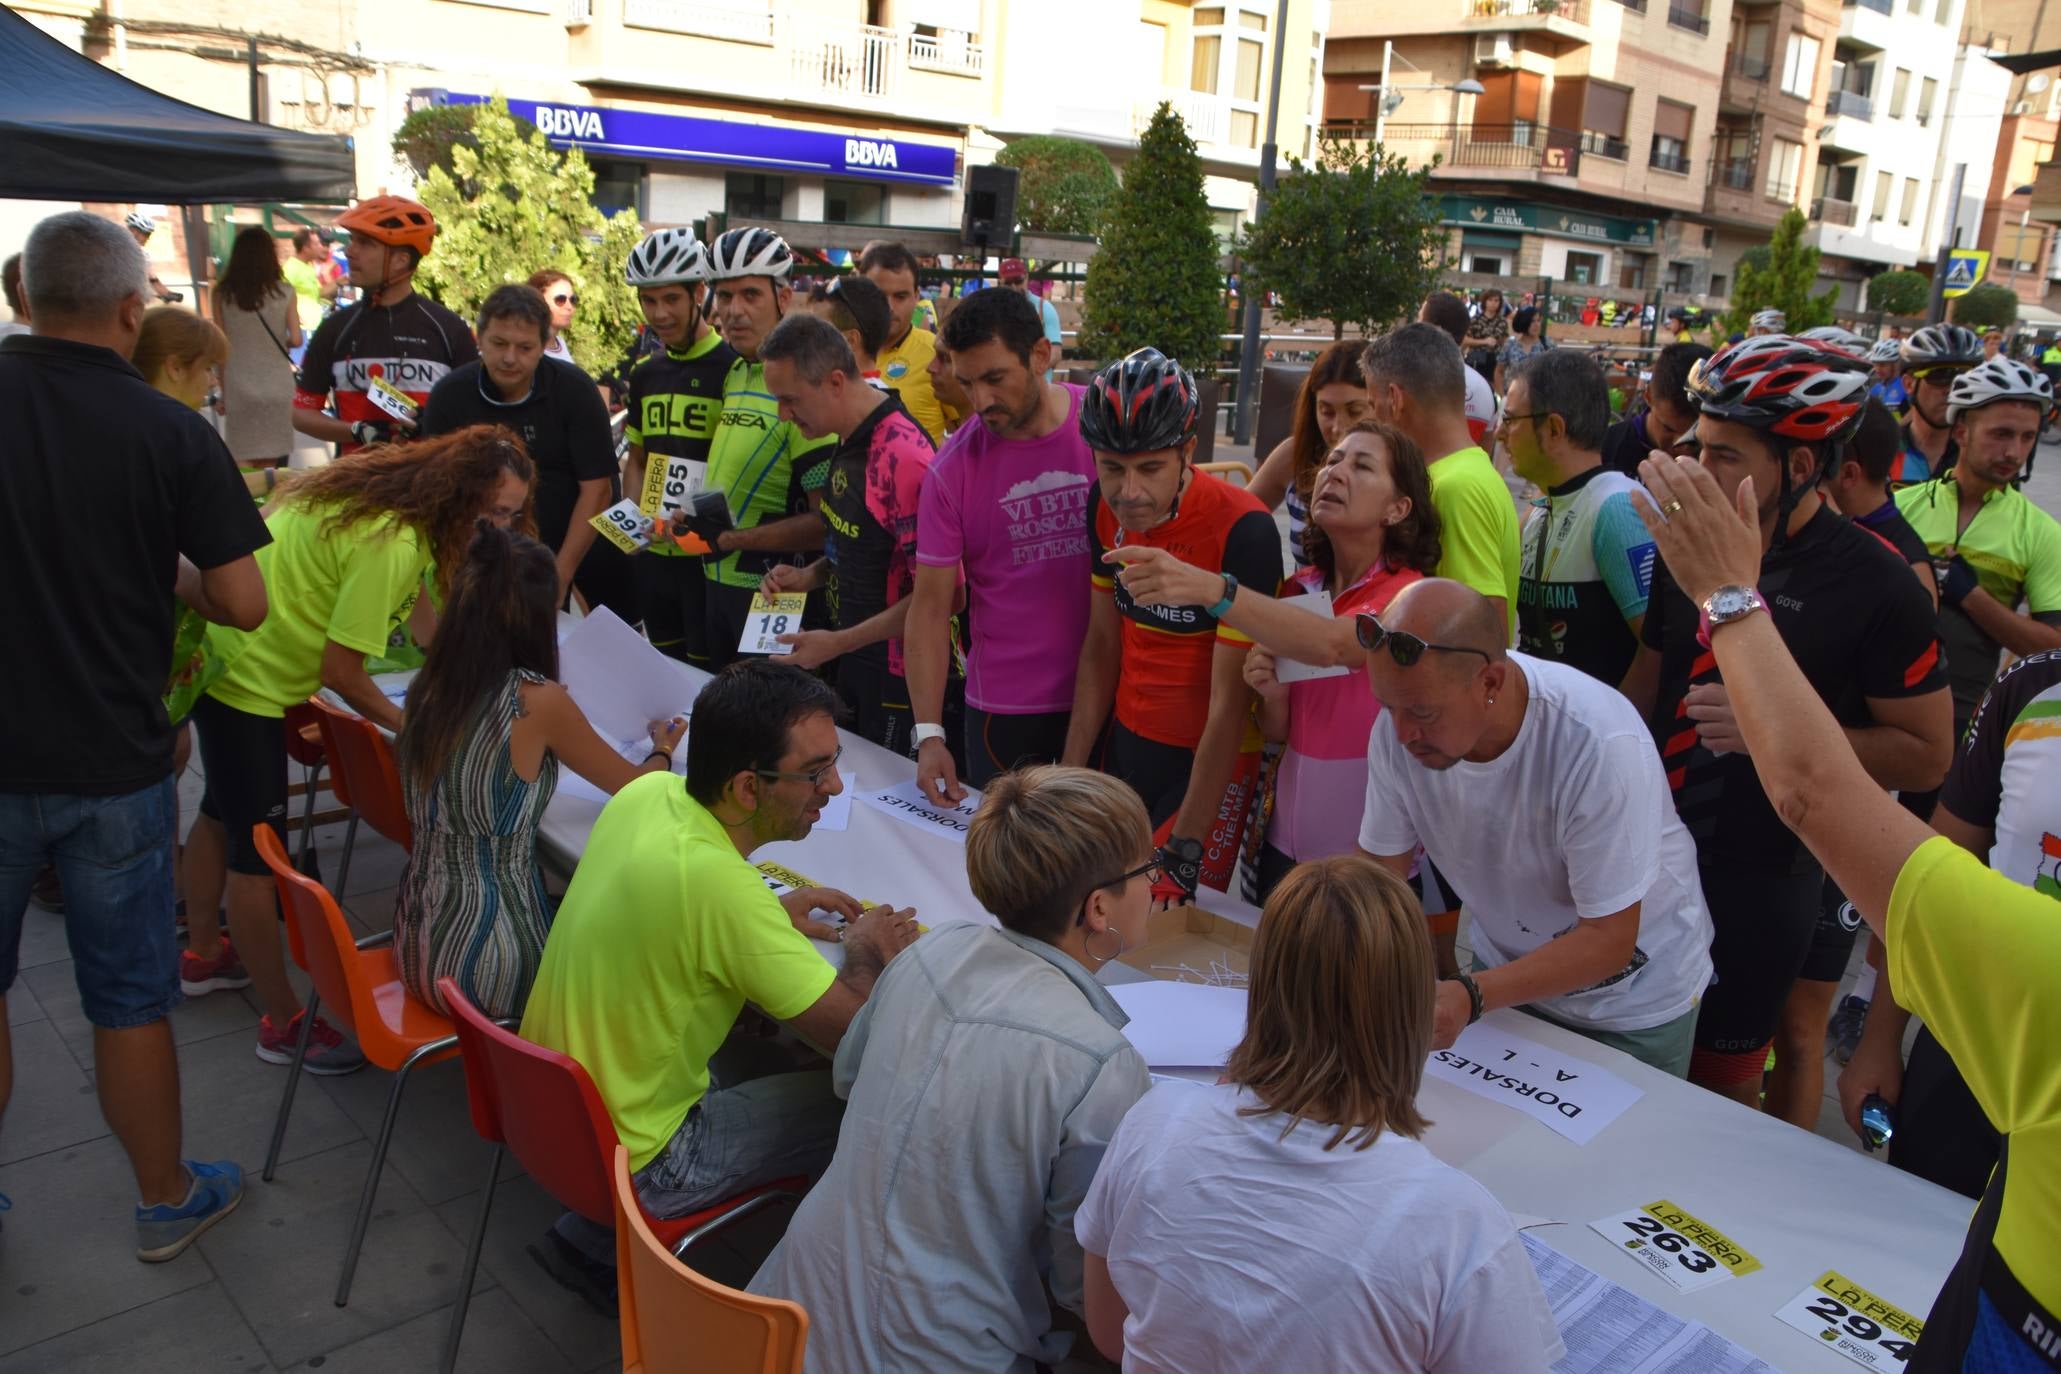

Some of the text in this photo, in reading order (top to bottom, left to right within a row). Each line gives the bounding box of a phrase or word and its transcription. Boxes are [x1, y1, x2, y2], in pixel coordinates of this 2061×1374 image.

[536, 106, 605, 139] BBVA
[845, 139, 898, 168] BBVA
[720, 413, 767, 430] RBEA
[650, 458, 666, 493] PERA
[663, 464, 689, 512] 165
[1001, 487, 1090, 522] VI BTT
[1775, 594, 1804, 612] GORE
[760, 614, 788, 635] 18
[877, 795, 969, 833] DORSALES
[1217, 783, 1240, 822] MTB
[1502, 1049, 1518, 1061] L
[1715, 1038, 1759, 1050] GORE
[1434, 1050, 1583, 1119] DORSALES
[1555, 1069, 1580, 1082] A
[1622, 1217, 1717, 1273] 263
[1649, 1205, 1743, 1266] LA PERA
[1823, 1278, 1923, 1339] LA PER
[1804, 1296, 1916, 1362] 294
